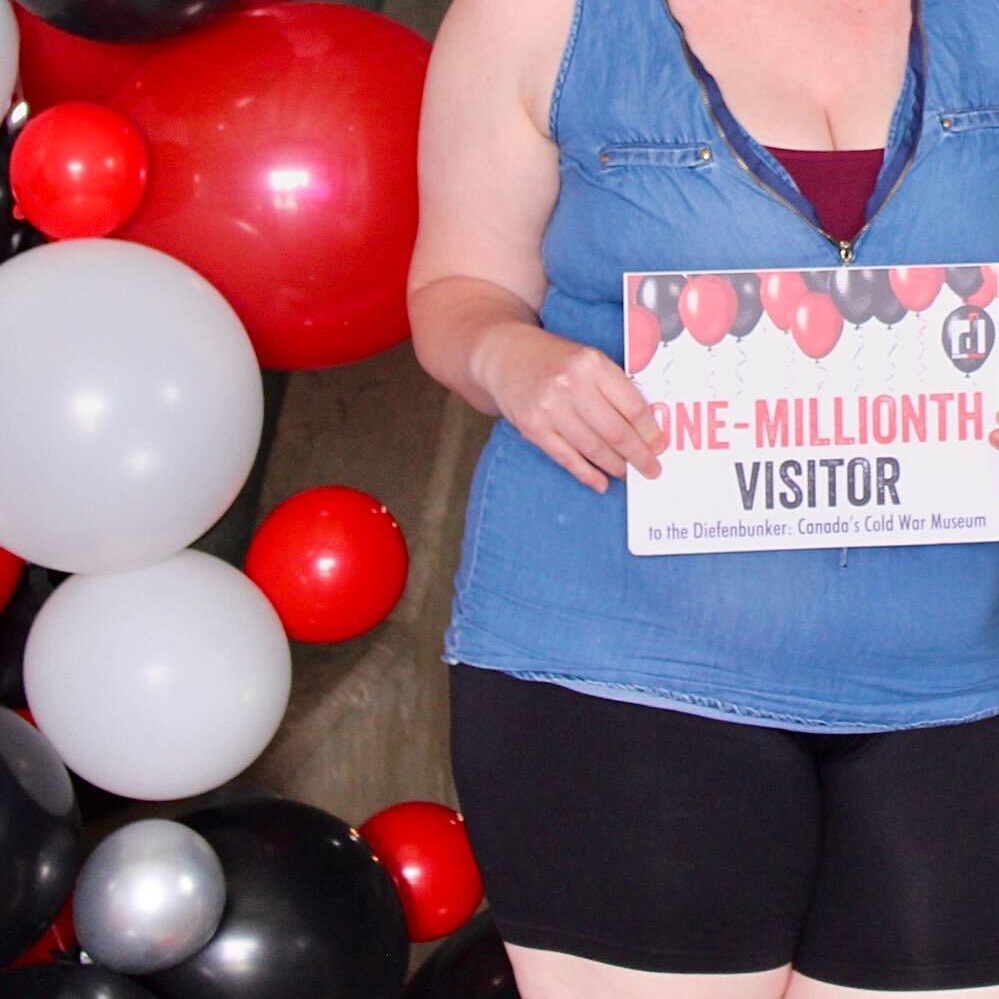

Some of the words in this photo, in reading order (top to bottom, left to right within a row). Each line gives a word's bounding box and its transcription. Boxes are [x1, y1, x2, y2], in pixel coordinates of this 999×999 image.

[650, 392, 983, 451] ONE-MILLIONTH
[735, 456, 901, 511] VISITOR
[648, 526, 662, 541] to
[667, 523, 688, 540] the
[693, 519, 793, 540] Diefenbunker:
[798, 516, 860, 536] Canada's
[864, 514, 894, 533] Cold
[899, 513, 926, 531] War
[931, 513, 987, 530] Museum
